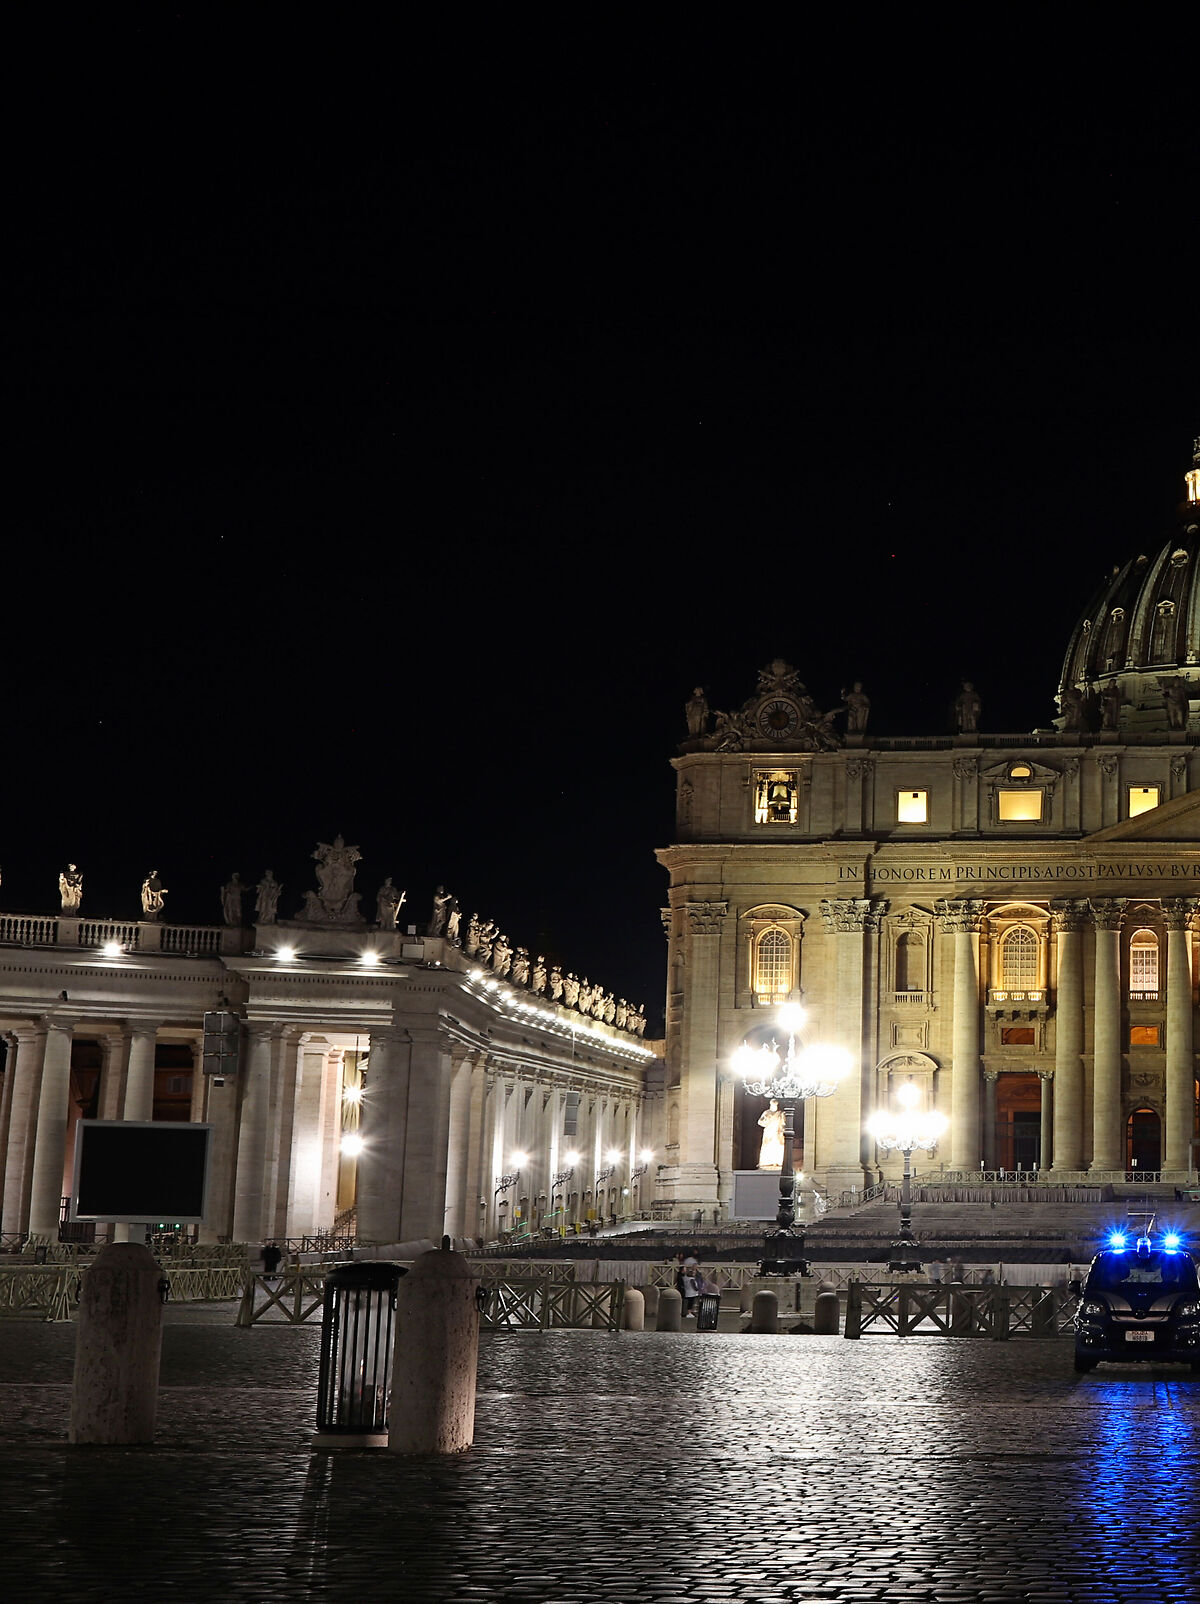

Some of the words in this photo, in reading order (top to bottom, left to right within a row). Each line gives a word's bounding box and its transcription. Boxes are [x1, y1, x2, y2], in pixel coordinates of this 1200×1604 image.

[839, 866, 858, 879] IN
[867, 867, 952, 880] HONOREM
[956, 866, 1040, 879] PRINCIPIS
[1045, 865, 1096, 879] APOST
[1097, 864, 1154, 877] PAVLVS
[1157, 864, 1168, 876] V
